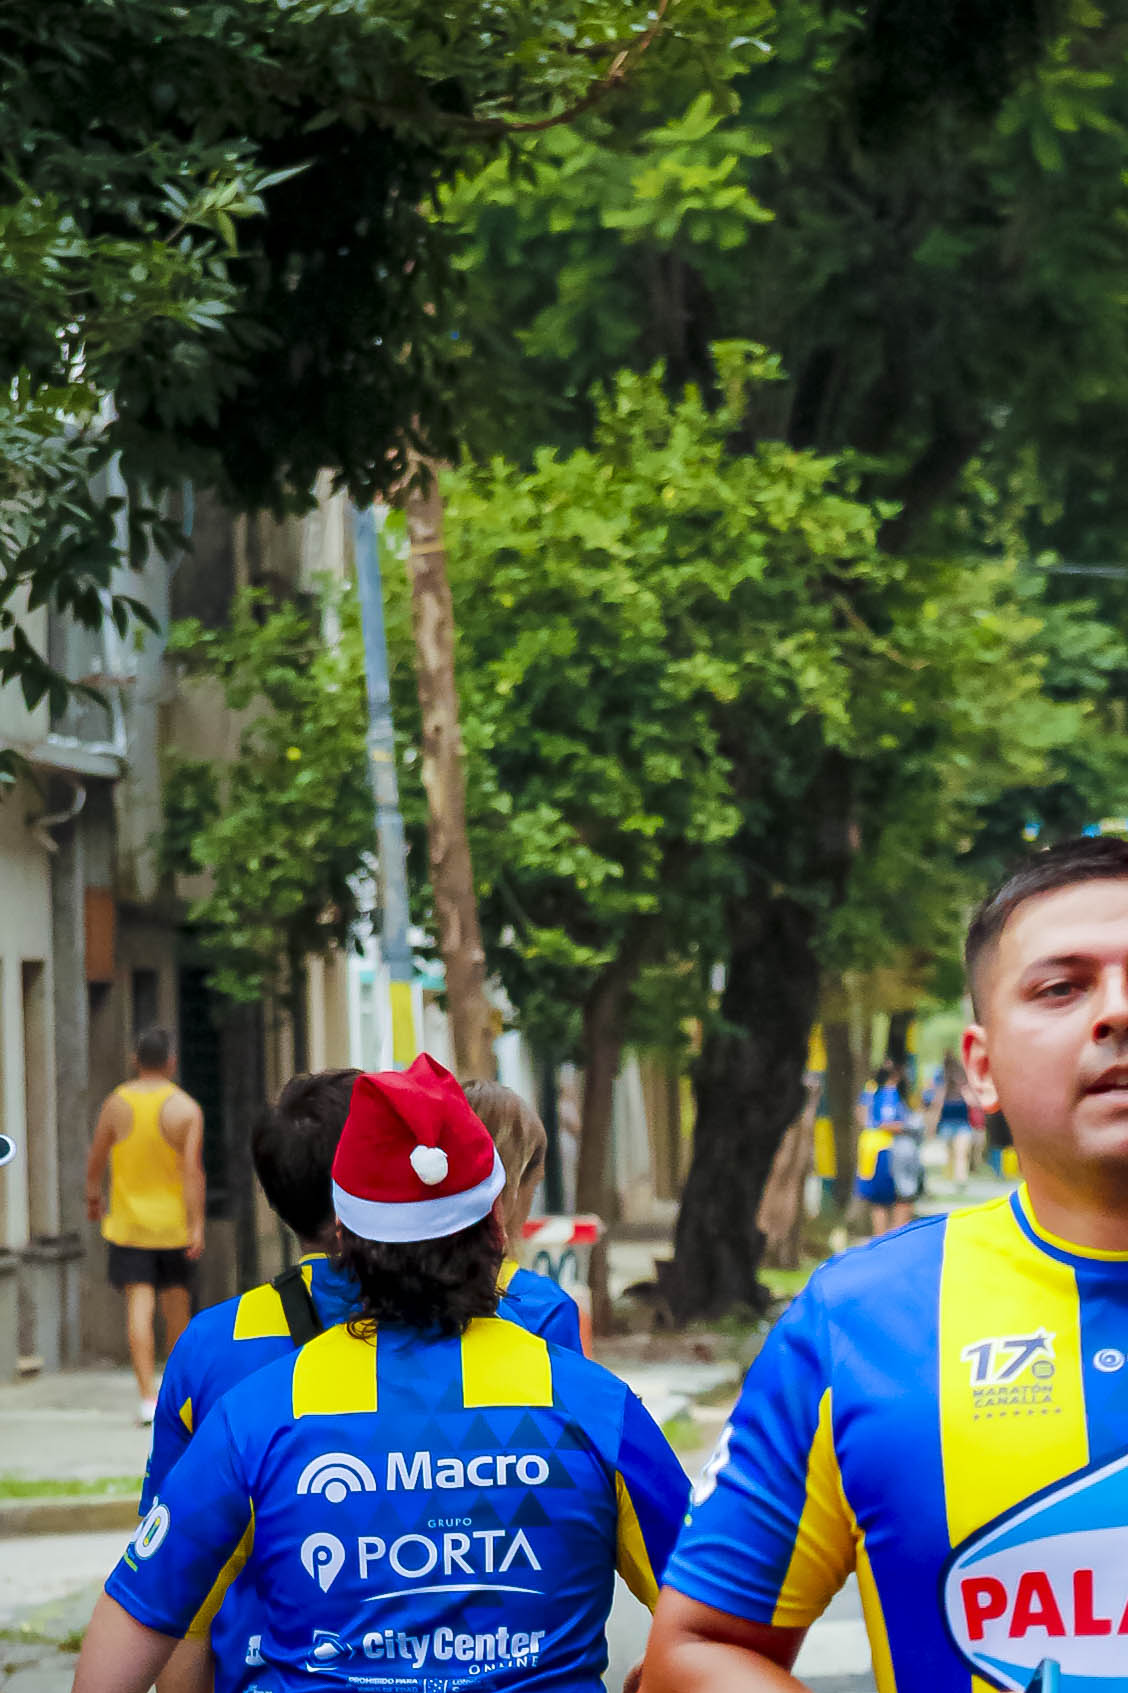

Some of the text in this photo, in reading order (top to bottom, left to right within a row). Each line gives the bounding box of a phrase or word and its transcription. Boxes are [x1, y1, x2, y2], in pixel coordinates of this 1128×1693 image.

[386, 1451, 549, 1490] Macro
[427, 1517, 472, 1528] GRUPO
[358, 1528, 543, 1580] PORTA
